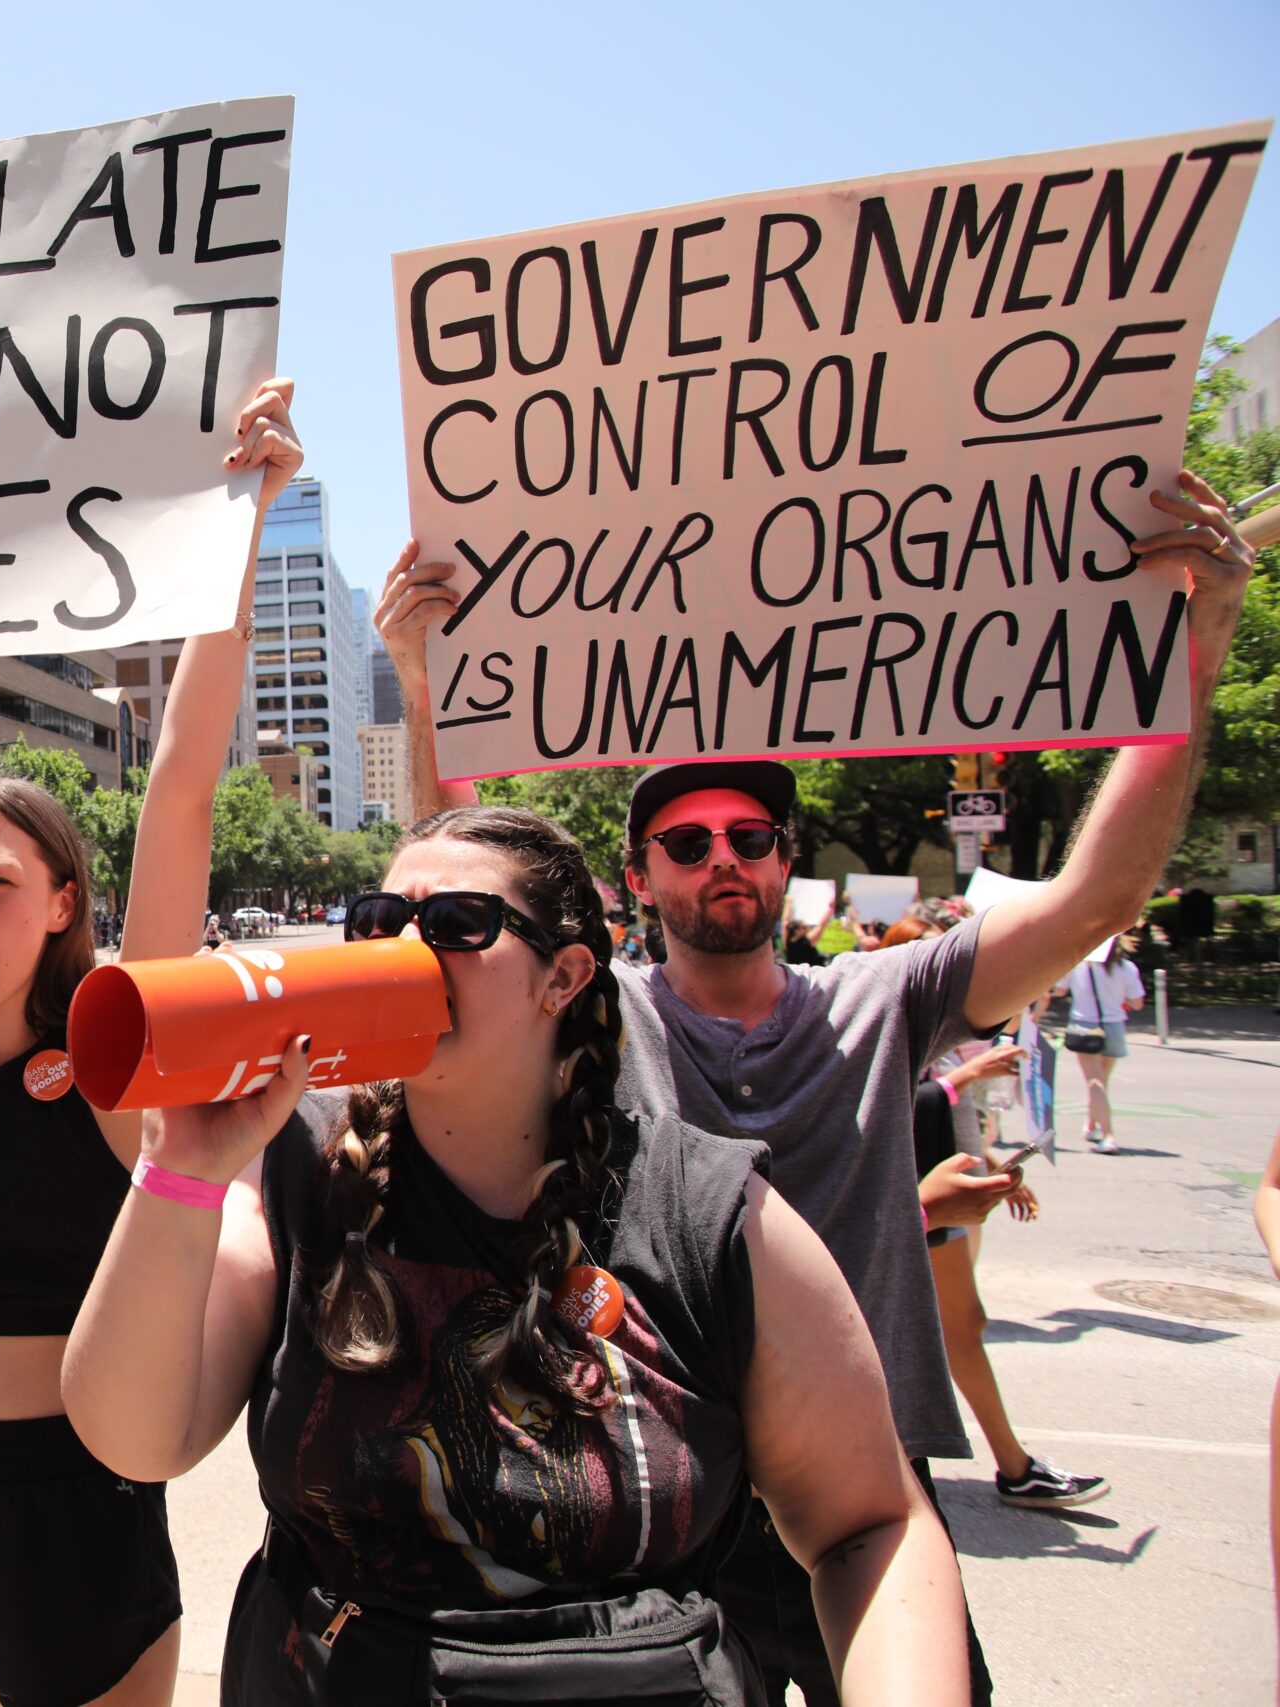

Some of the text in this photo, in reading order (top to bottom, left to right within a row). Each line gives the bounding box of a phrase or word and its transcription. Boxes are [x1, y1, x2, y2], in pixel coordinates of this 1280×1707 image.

[410, 139, 1267, 385] GOVERNMENT
[423, 319, 1187, 504] CONTROL OF
[441, 455, 1150, 637] YOUR ORGANS
[436, 591, 1188, 760] IS UNAMERICAN
[31, 1069, 67, 1093] BODIES
[48, 1060, 69, 1075] OUR
[576, 1290, 610, 1328] ODIES
[581, 1276, 608, 1304] OUR
